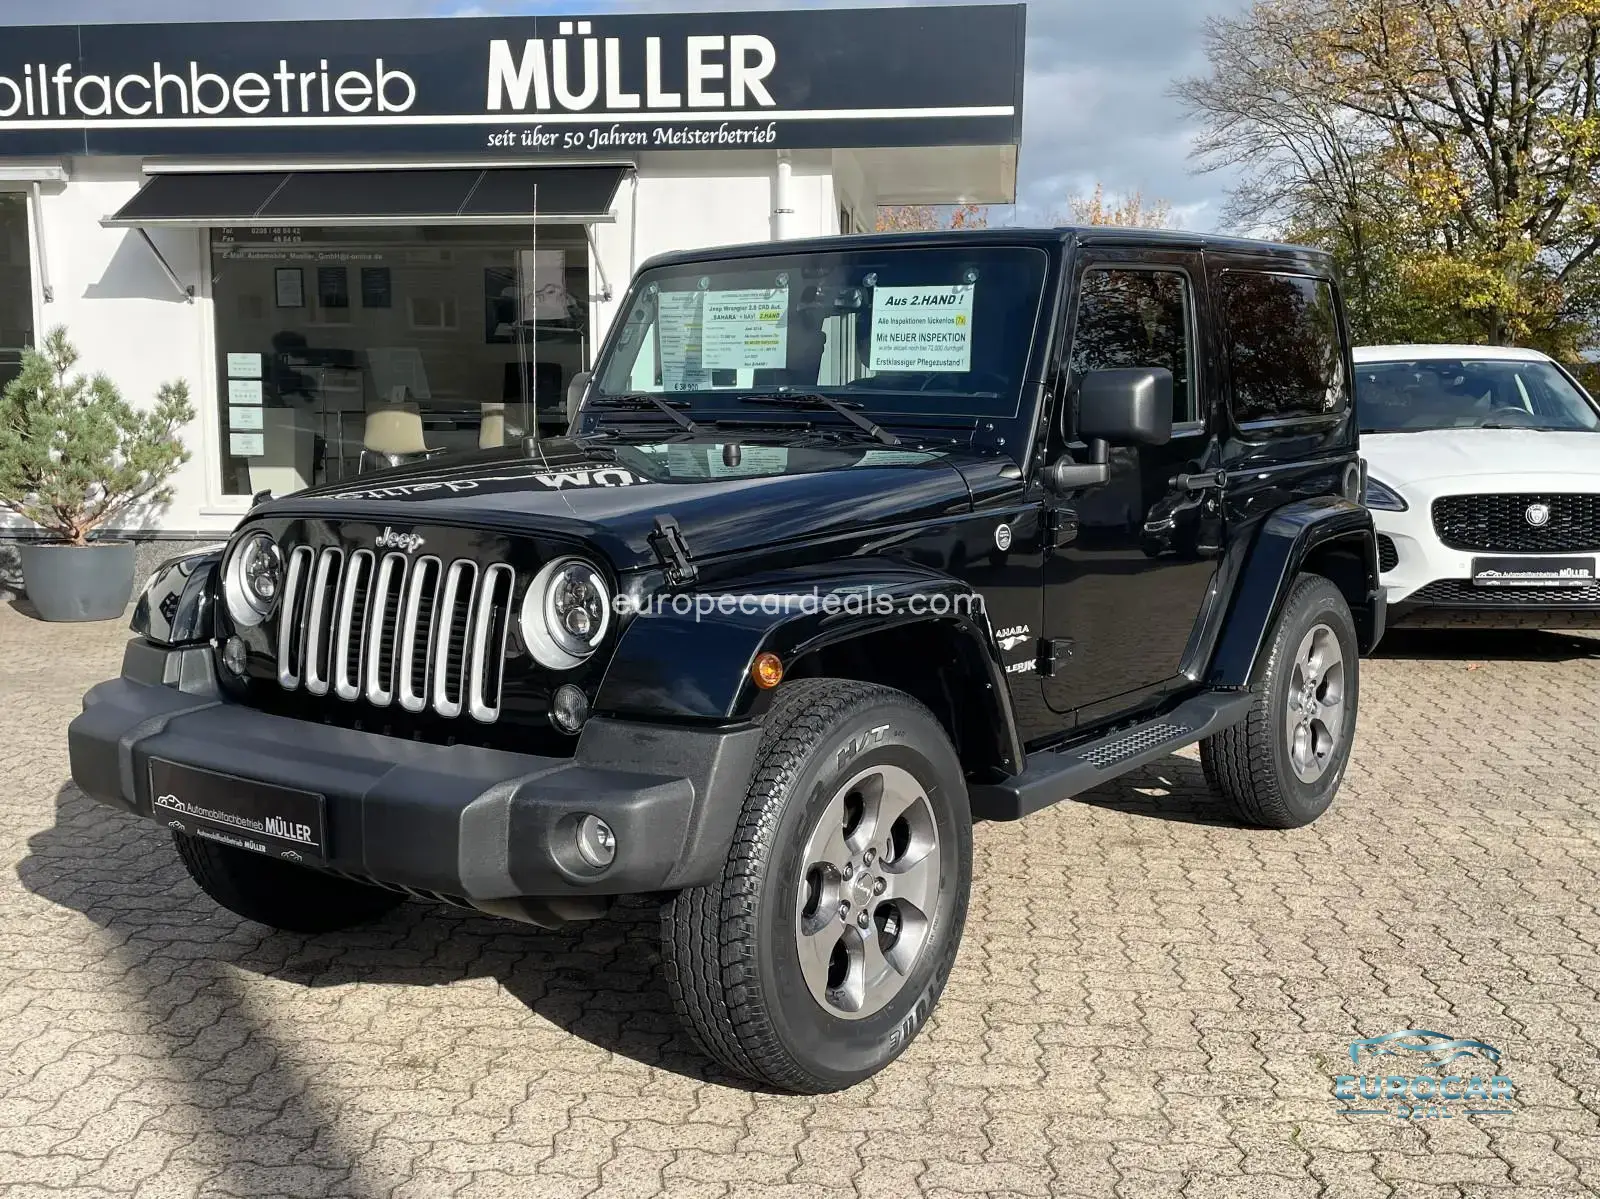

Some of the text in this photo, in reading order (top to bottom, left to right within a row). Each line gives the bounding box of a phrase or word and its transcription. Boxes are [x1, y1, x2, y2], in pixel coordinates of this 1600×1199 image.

[487, 21, 776, 112] MÜLLER
[487, 122, 777, 150] seit über 50 Jahren Meisterbetrieb
[885, 294, 964, 306] Aus 2.HAND !
[890, 316, 926, 326] Inspektionen
[876, 332, 967, 342] Mit NEUER INSPEKTION
[876, 357, 916, 367] Erstklassiger
[917, 357, 960, 367] Pflegezustand
[375, 526, 424, 554] Jeep
[1559, 567, 1589, 578] MÜLLER
[995, 624, 1030, 638] AHARA
[186, 801, 312, 842] Automobilfachbetrieb MÜLLER
[243, 839, 266, 853] MÜLLER
